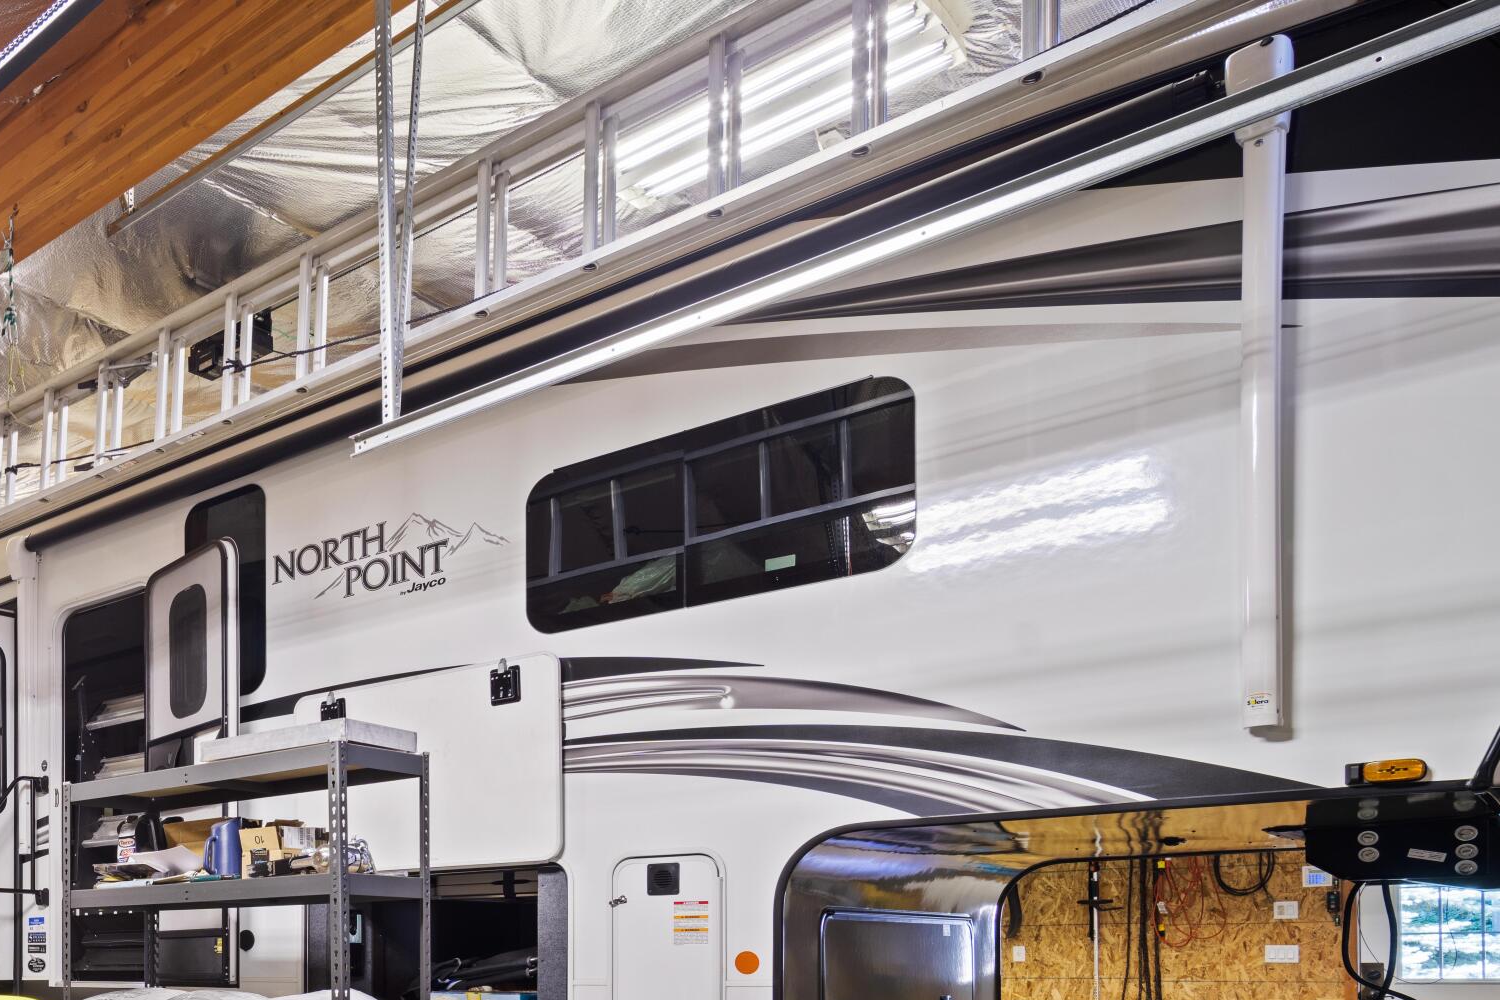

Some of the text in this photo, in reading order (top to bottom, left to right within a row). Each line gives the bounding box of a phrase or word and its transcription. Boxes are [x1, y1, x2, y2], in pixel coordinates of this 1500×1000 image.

[272, 521, 387, 585] NORTH
[343, 538, 449, 598] POINT
[407, 577, 446, 593] Jayco
